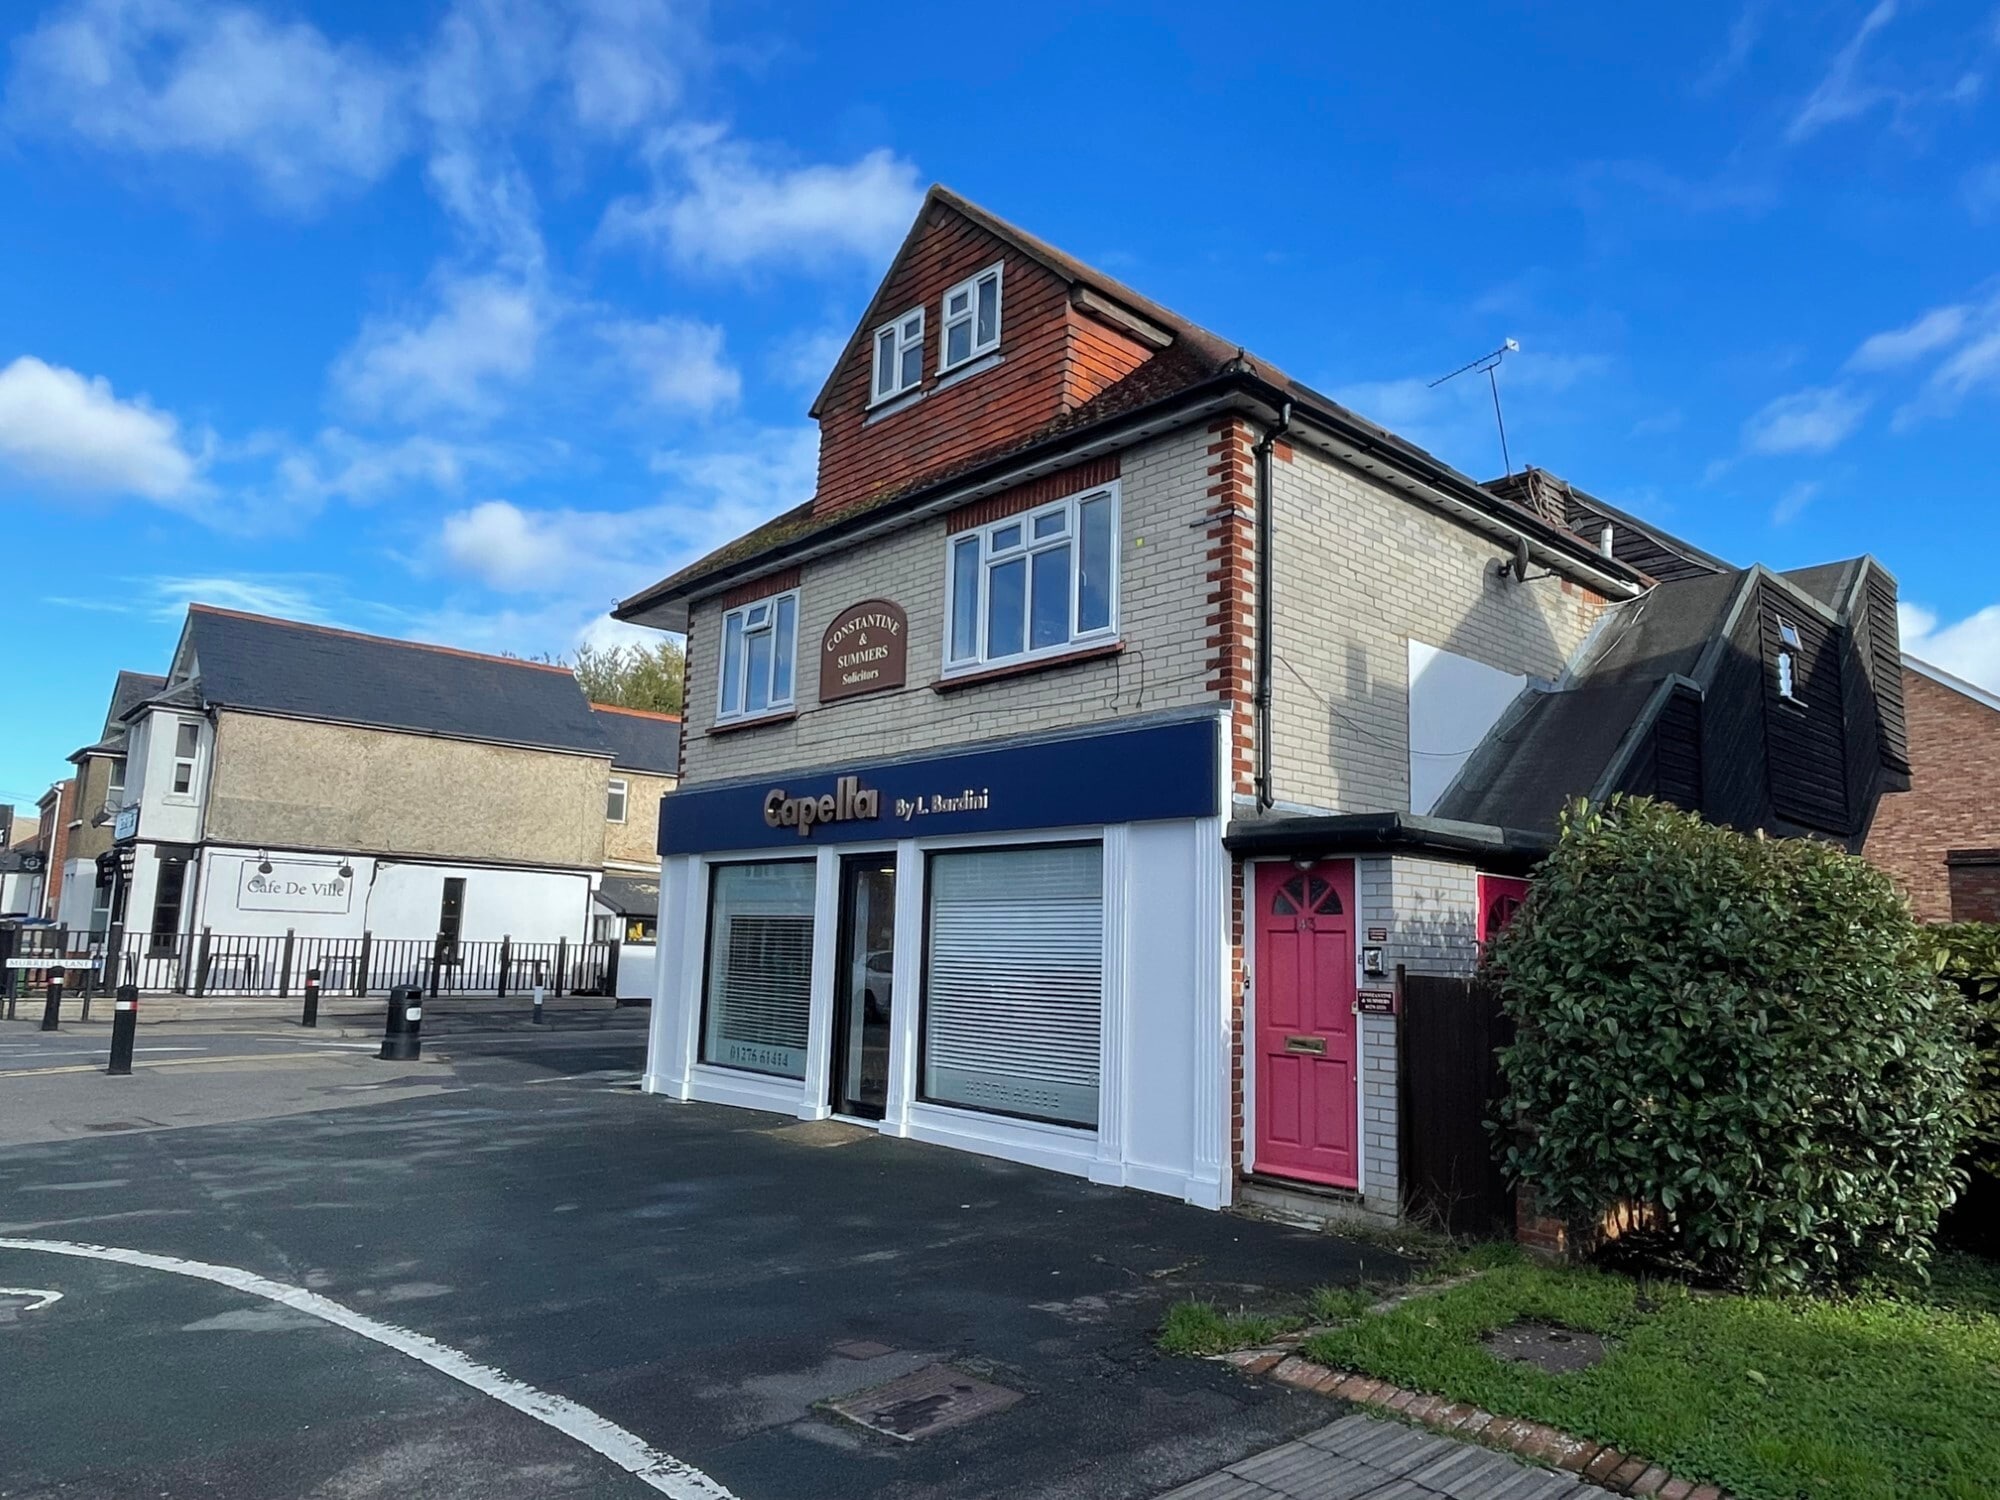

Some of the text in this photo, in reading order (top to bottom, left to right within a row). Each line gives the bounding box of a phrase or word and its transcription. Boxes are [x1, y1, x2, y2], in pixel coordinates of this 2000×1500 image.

[826, 613, 901, 652] CONSTANTINE
[858, 632, 868, 646] &
[837, 645, 889, 669] SUMMERS
[841, 669, 880, 685] Solicitors
[764, 775, 880, 837] Capella
[894, 788, 990, 821] By L. Bardini
[247, 879, 344, 898] Cafe De Ville
[730, 1044, 757, 1063] 01276
